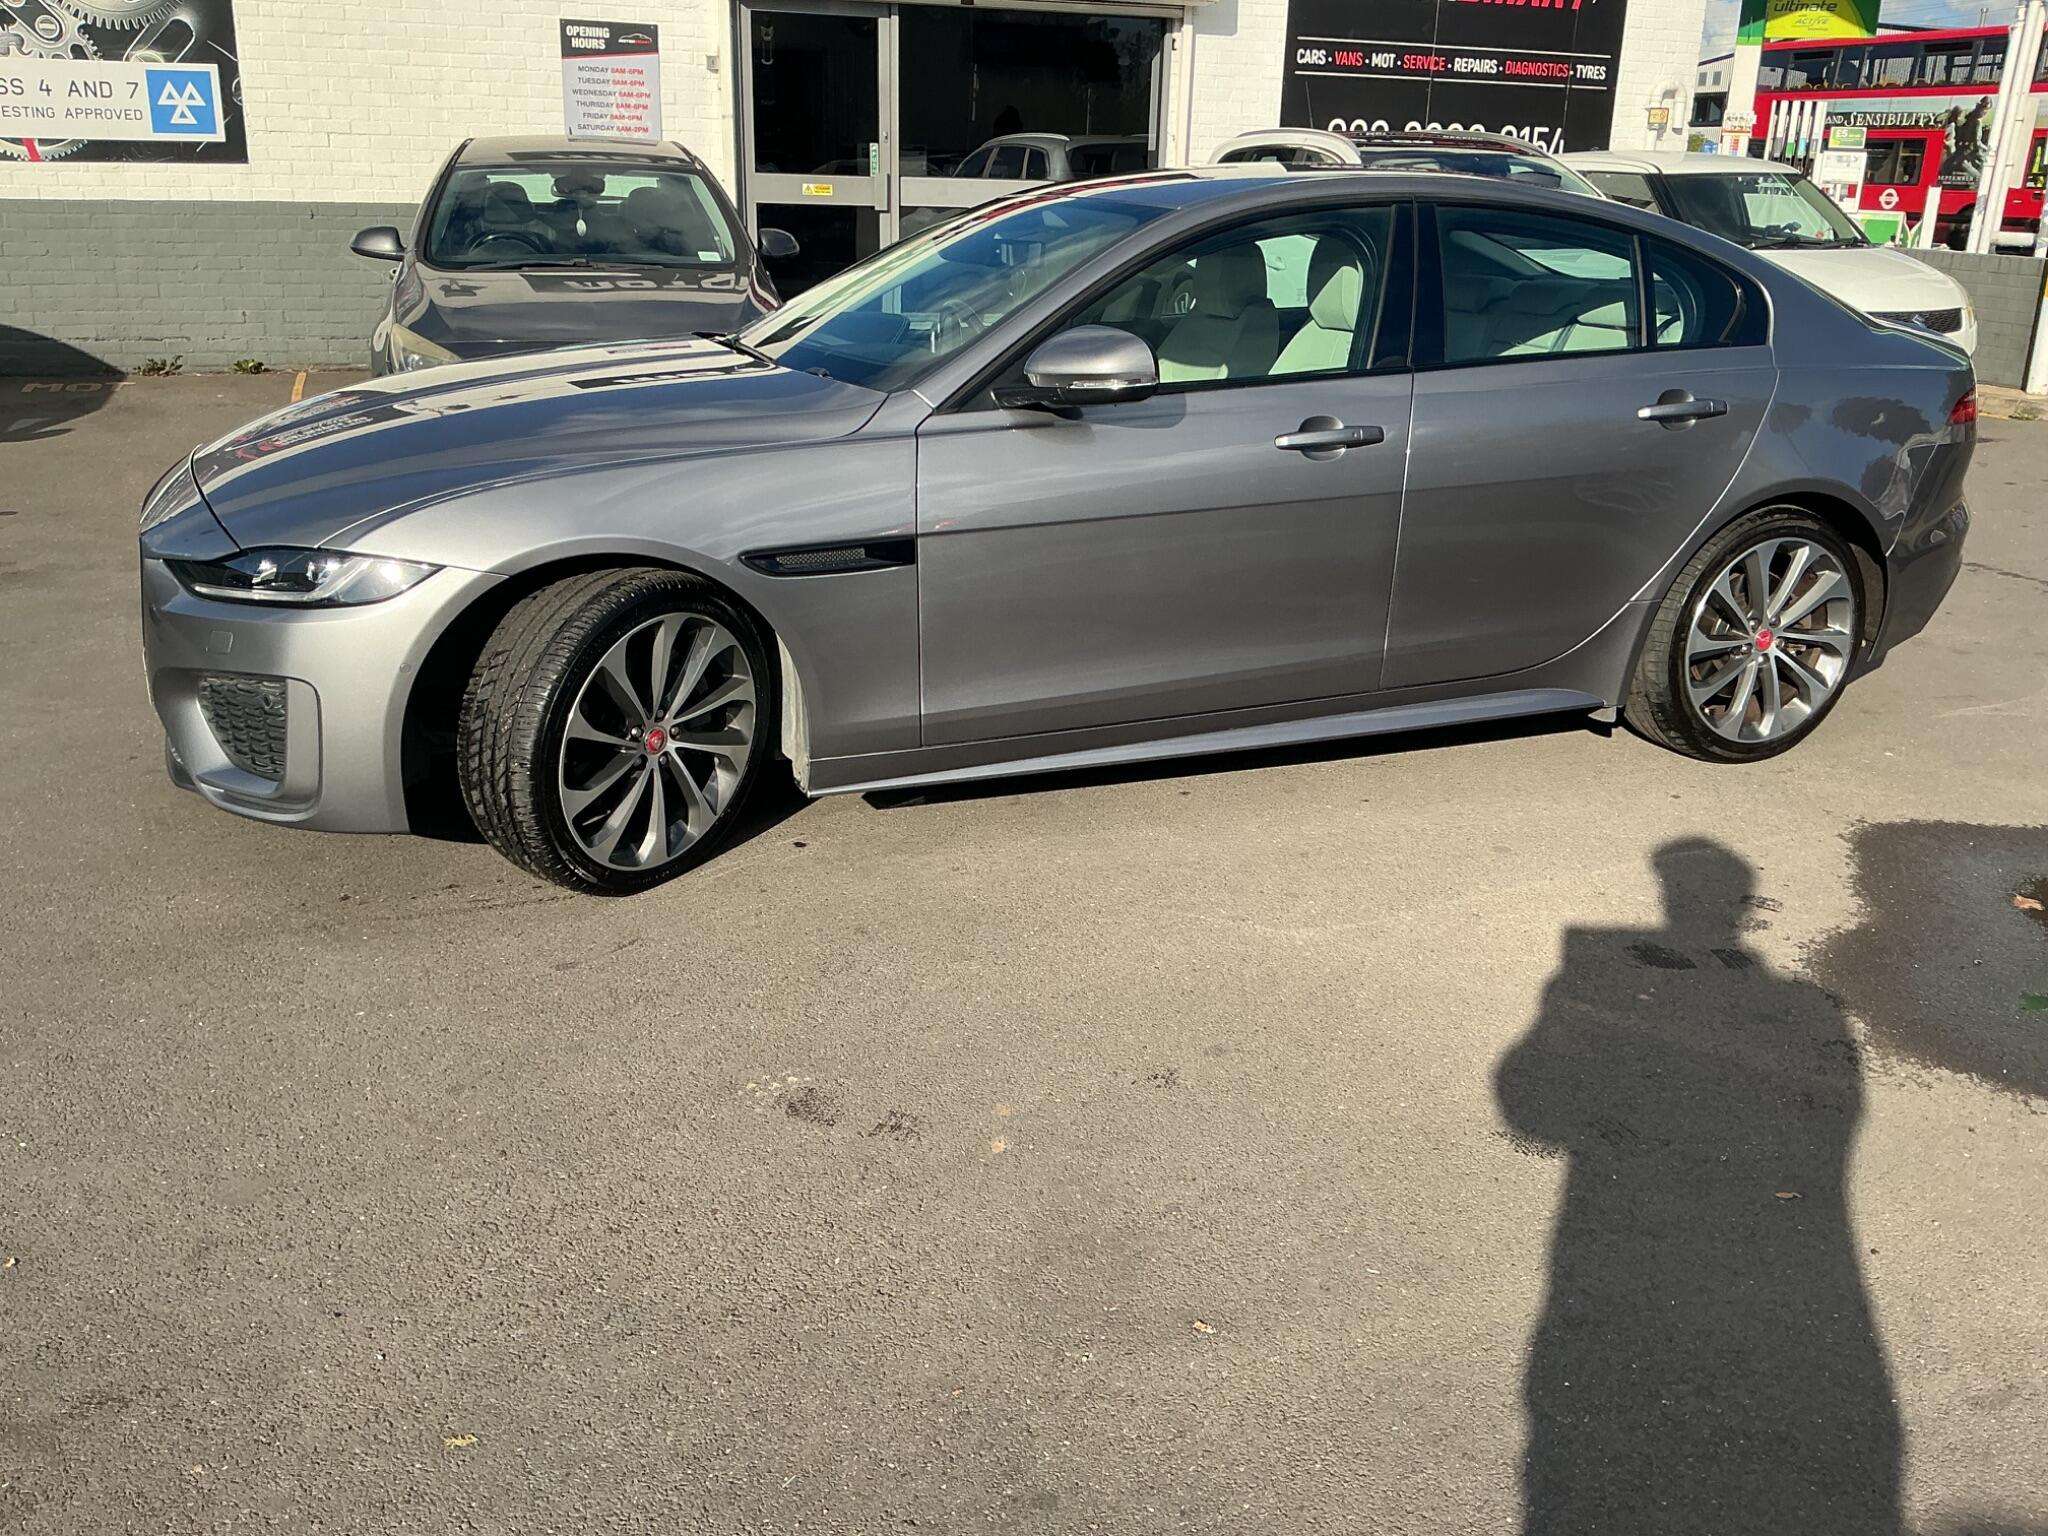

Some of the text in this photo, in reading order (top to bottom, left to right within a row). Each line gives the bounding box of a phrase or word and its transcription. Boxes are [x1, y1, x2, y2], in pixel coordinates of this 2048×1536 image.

[566, 25, 610, 38] OPENING
[572, 37, 605, 49] HOURS
[1296, 48, 1607, 80] CARS VANS MOT SERVICE REPAIRS DIAGNOSTICS TYRES
[39, 79, 52, 96] 4
[68, 80, 113, 99] AND
[126, 82, 139, 99] 7
[572, 89, 617, 97] WEDNESDAY
[576, 100, 614, 108] THURSDAY
[65, 107, 143, 121] APPROVED
[583, 112, 608, 120] FRIDAY
[1844, 111, 1937, 127] SENSIBILITY
[577, 123, 615, 131] SATURDAY
[21, 381, 136, 392] MOT
